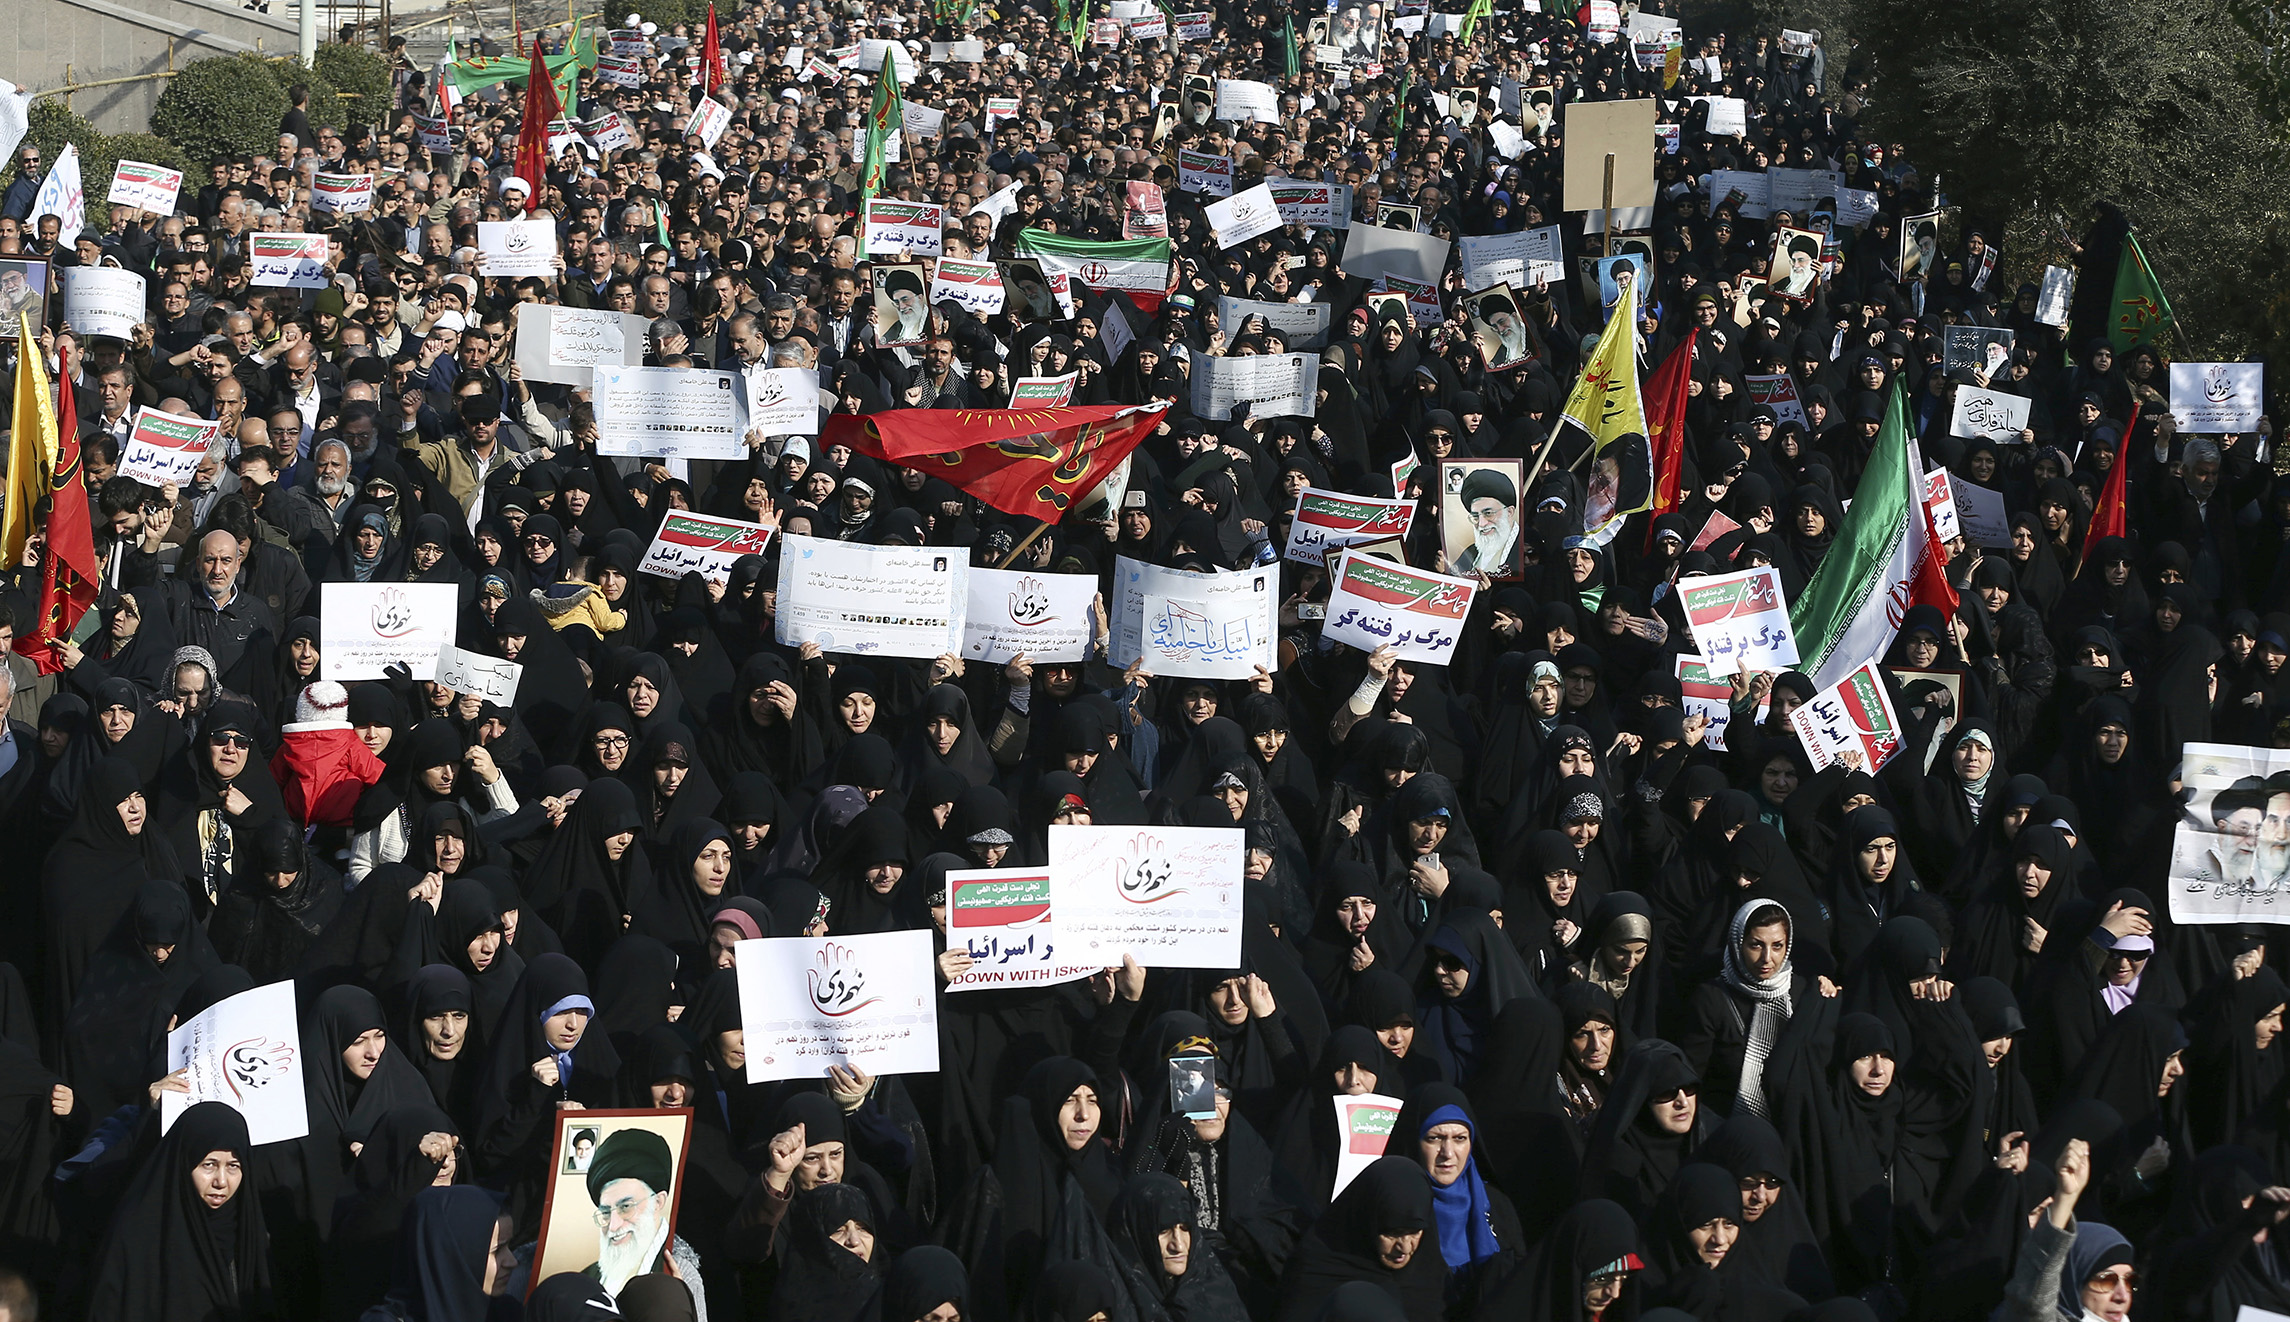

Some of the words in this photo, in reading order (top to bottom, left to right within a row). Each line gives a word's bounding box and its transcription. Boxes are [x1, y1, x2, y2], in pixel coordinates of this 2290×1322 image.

[1213, 178, 1230, 191] مرگ
[351, 197, 368, 206] مرگ
[1310, 209, 1329, 217] مرگ
[904, 236, 915, 247] بر
[916, 235, 939, 249] مرگ
[290, 267, 300, 279] بر
[968, 296, 979, 306] بر
[981, 293, 1001, 307] مرگ
[128, 448, 175, 469] اسرائیل
[122, 467, 152, 480] DOWN
[173, 462, 184, 474] بر
[651, 547, 705, 568] اسرائیل
[644, 563, 678, 577] DOWN
[703, 562, 719, 574] بر
[1388, 574, 1400, 582] دست
[1390, 629, 1412, 646] بر
[1415, 629, 1452, 650] مرگ
[1752, 624, 1786, 651] مرگ
[1736, 636, 1749, 658] بر
[1812, 695, 1850, 745] اسرائیل
[1810, 741, 1829, 768] WITH
[976, 885, 990, 895] الهی
[991, 883, 1008, 894] قدرت
[1009, 884, 1025, 892] دست
[1027, 883, 1040, 891] تجلی
[1123, 925, 1143, 933] محکمی
[1161, 924, 1177, 934] کشور
[1179, 926, 1196, 934] سراسر
[1198, 926, 1205, 934] در
[1138, 936, 1149, 944] خود
[1158, 936, 1167, 944] کار
[1169, 937, 1178, 945] این
[953, 972, 1004, 985] DOWN
[1010, 969, 1050, 981] WITH
[799, 1036, 810, 1044] روز
[830, 1036, 835, 1044] را
[795, 1047, 806, 1056] کرد
